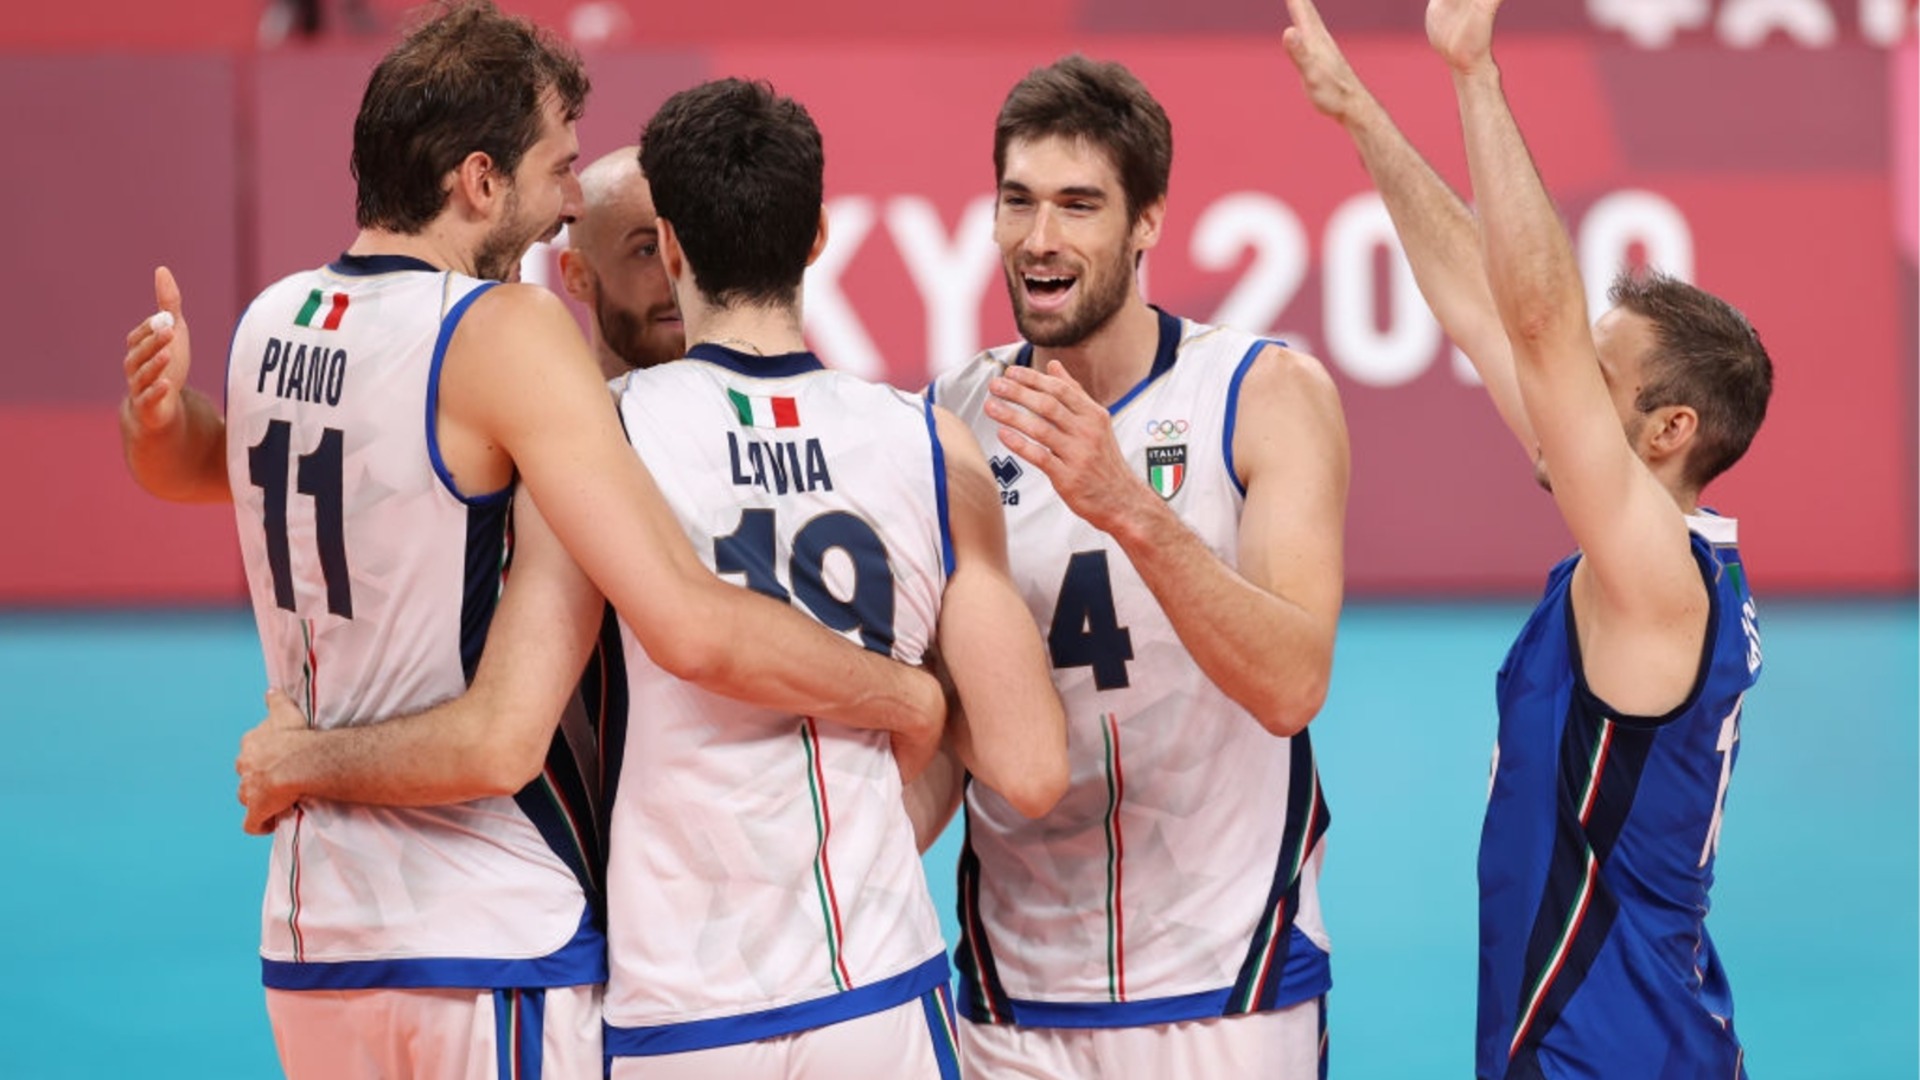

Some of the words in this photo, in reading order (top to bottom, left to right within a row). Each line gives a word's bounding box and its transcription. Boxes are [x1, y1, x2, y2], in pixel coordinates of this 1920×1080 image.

[258, 338, 347, 406] PIANO
[726, 431, 833, 495] LAVIA
[1148, 447, 1184, 459] ITALIA
[248, 419, 353, 620] 11
[713, 508, 895, 656] 19
[1047, 549, 1134, 692] 4
